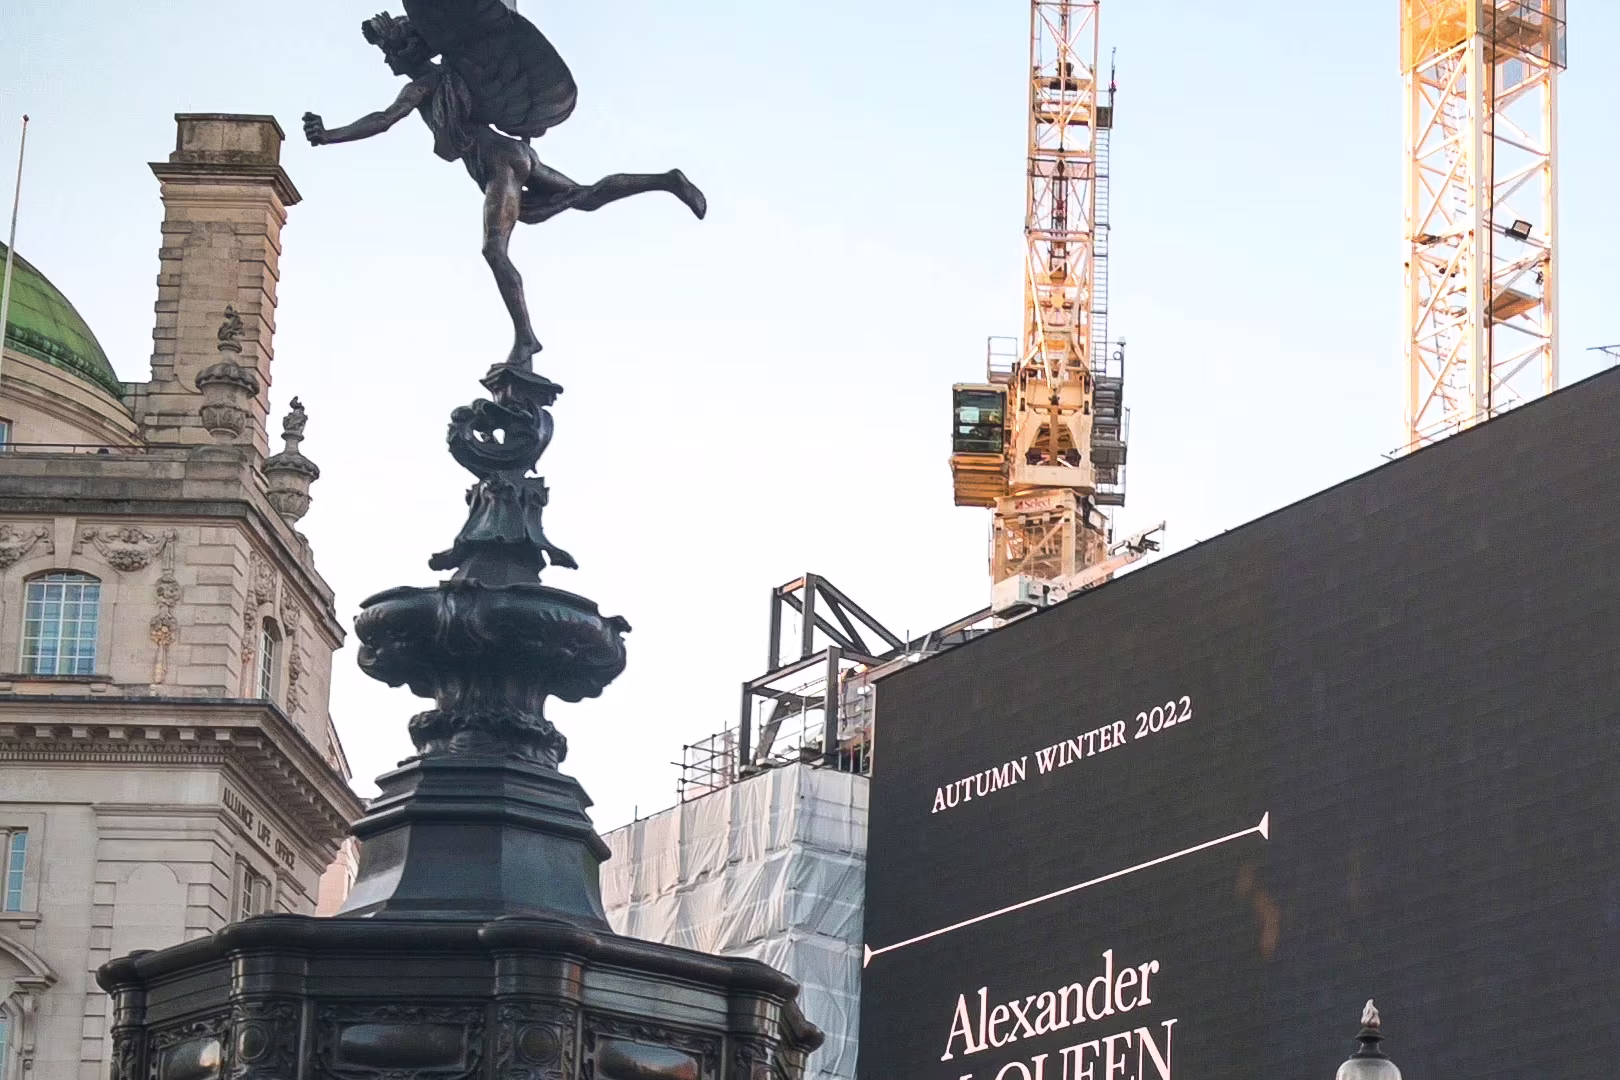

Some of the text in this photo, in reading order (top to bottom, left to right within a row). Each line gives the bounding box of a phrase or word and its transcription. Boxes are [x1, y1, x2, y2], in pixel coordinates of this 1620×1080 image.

[932, 695, 1193, 813] AUTUMN WINTER 2022
[941, 949, 1160, 1062] Alexander
